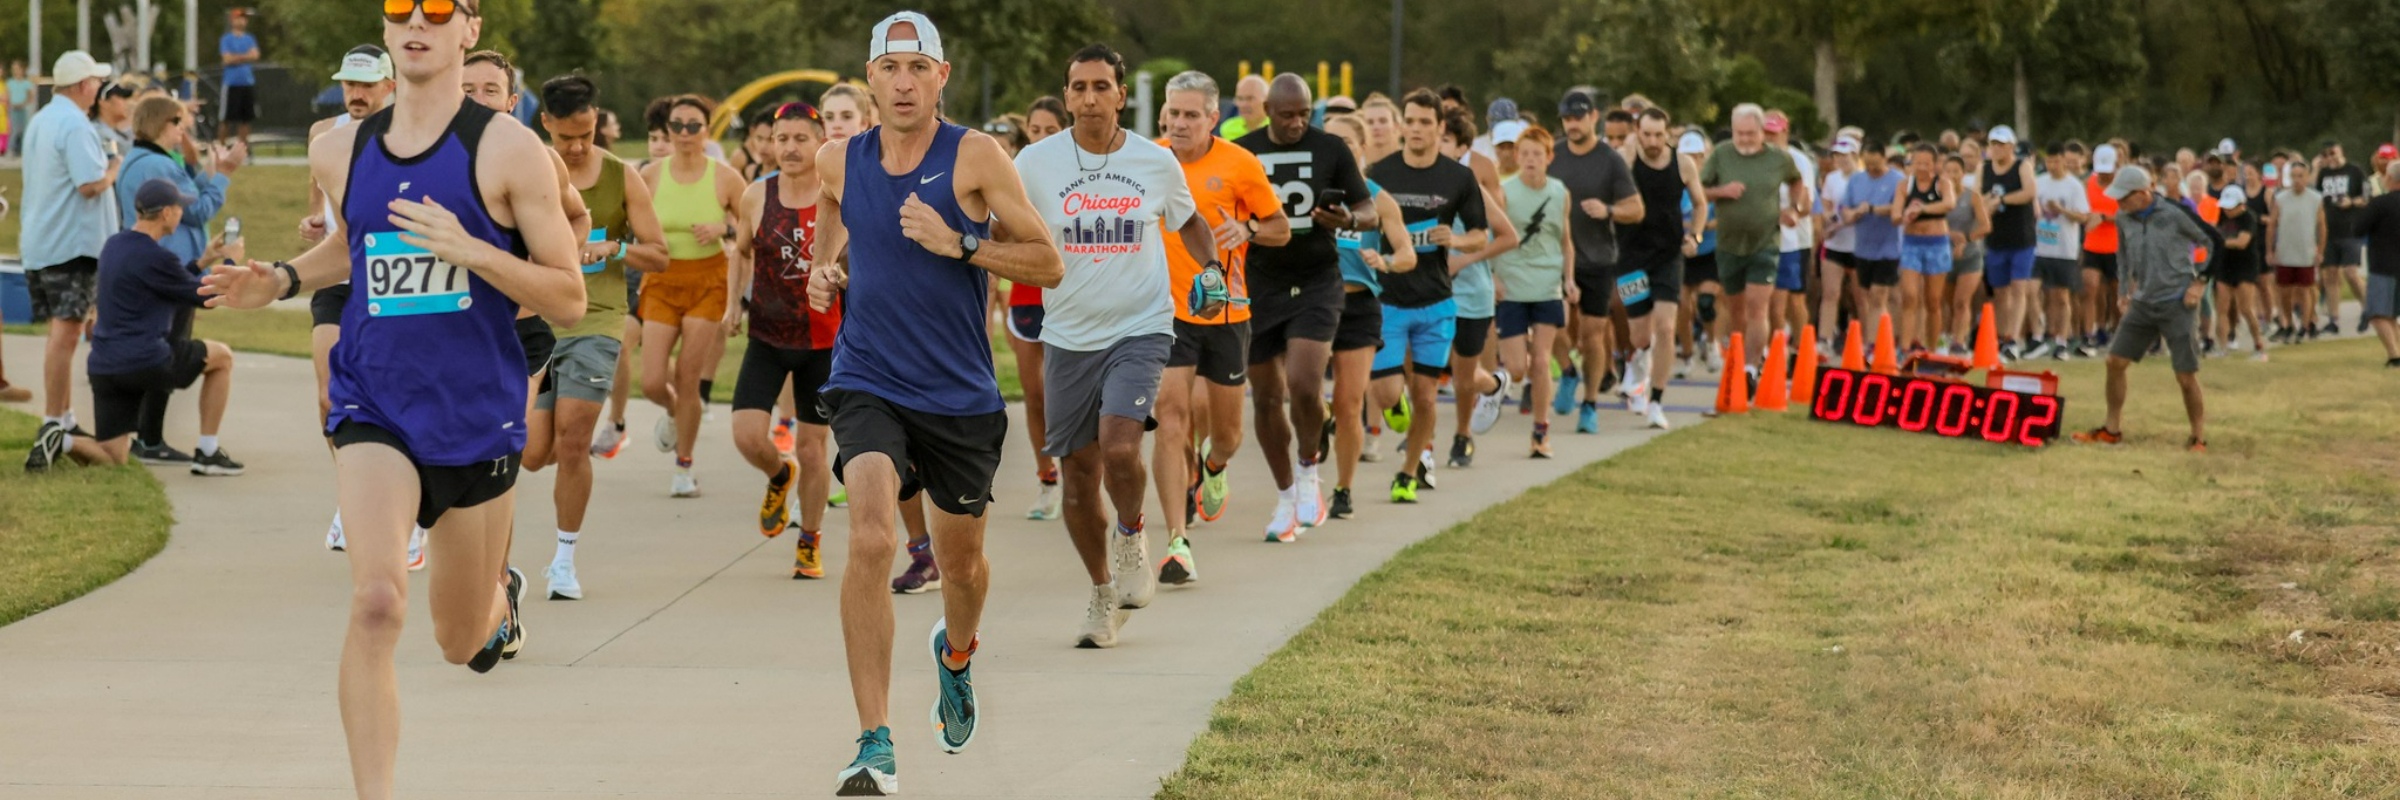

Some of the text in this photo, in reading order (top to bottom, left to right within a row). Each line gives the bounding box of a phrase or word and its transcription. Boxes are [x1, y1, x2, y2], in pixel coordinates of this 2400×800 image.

[1059, 172, 1146, 198] BANK OF AMERICA
[1063, 192, 1142, 216] Chicago
[1064, 243, 1142, 254] MARATHON '24
[370, 256, 458, 297] 9277
[1814, 369, 2058, 447] 00:00:02
